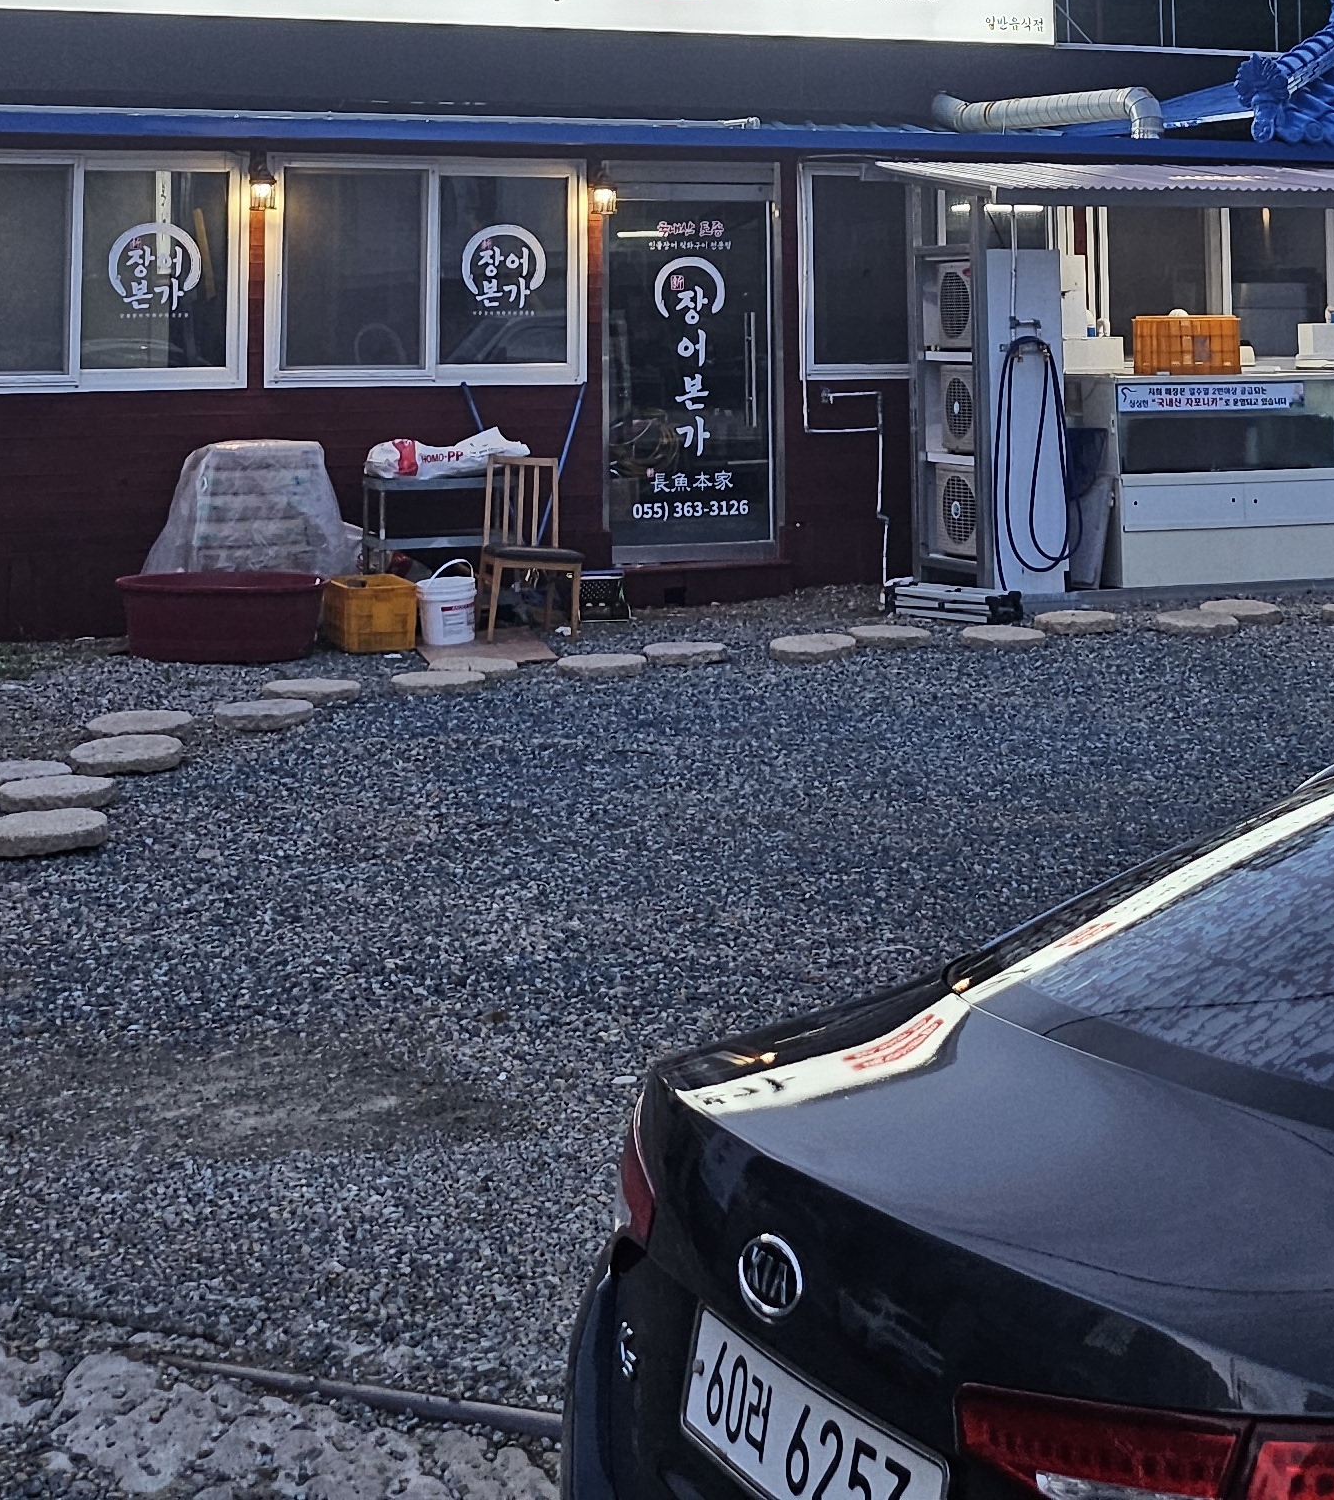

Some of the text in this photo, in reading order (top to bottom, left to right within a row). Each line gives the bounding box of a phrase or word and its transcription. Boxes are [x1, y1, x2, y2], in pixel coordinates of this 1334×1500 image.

[986, 16, 1043, 32] 일반음식점
[126, 245, 182, 277] 장어
[478, 246, 529, 276] 장어
[123, 278, 184, 310] 본가
[476, 277, 530, 308] 본가
[675, 286, 711, 456] 장어본가
[650, 470, 733, 493] 長魚本家
[633, 500, 748, 521] 055) 363-3126
